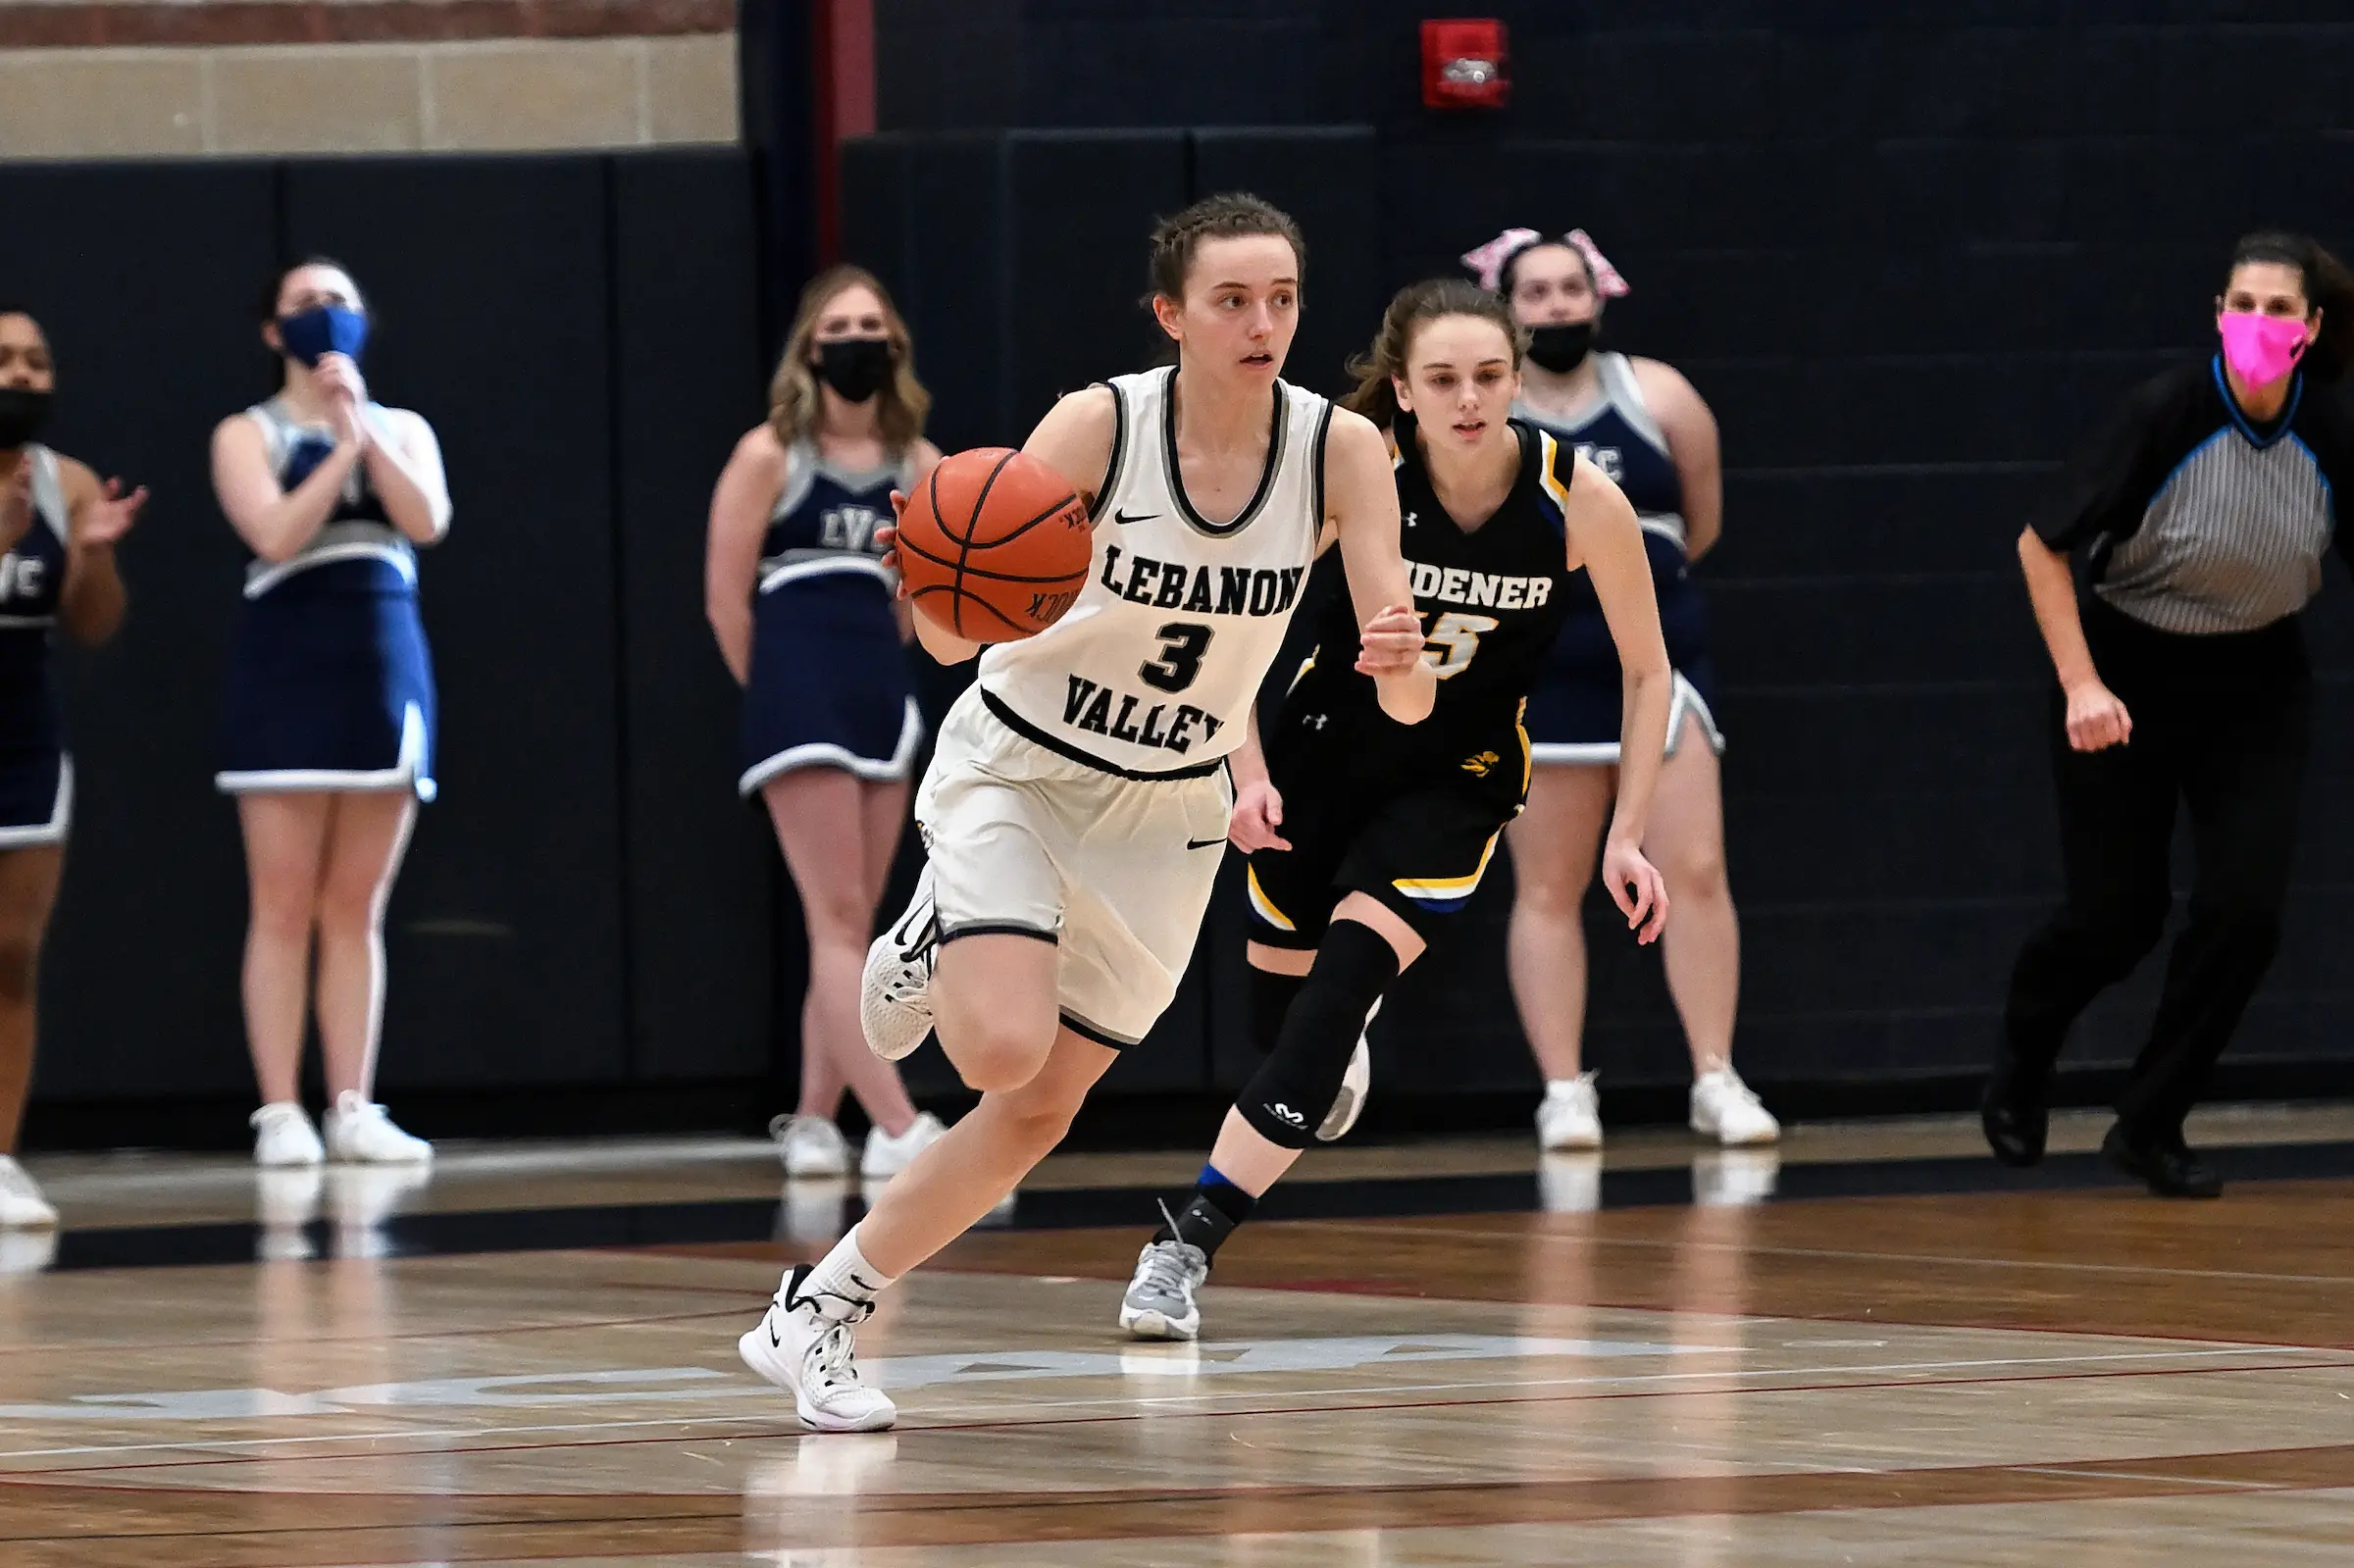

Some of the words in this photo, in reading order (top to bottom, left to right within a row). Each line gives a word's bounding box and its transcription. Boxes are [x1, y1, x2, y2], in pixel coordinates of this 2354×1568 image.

[1100, 543, 1305, 618] LEBANON
[1137, 621, 1216, 695] 3
[1414, 610, 1500, 681] 5
[1062, 673, 1225, 756] VALLEY
